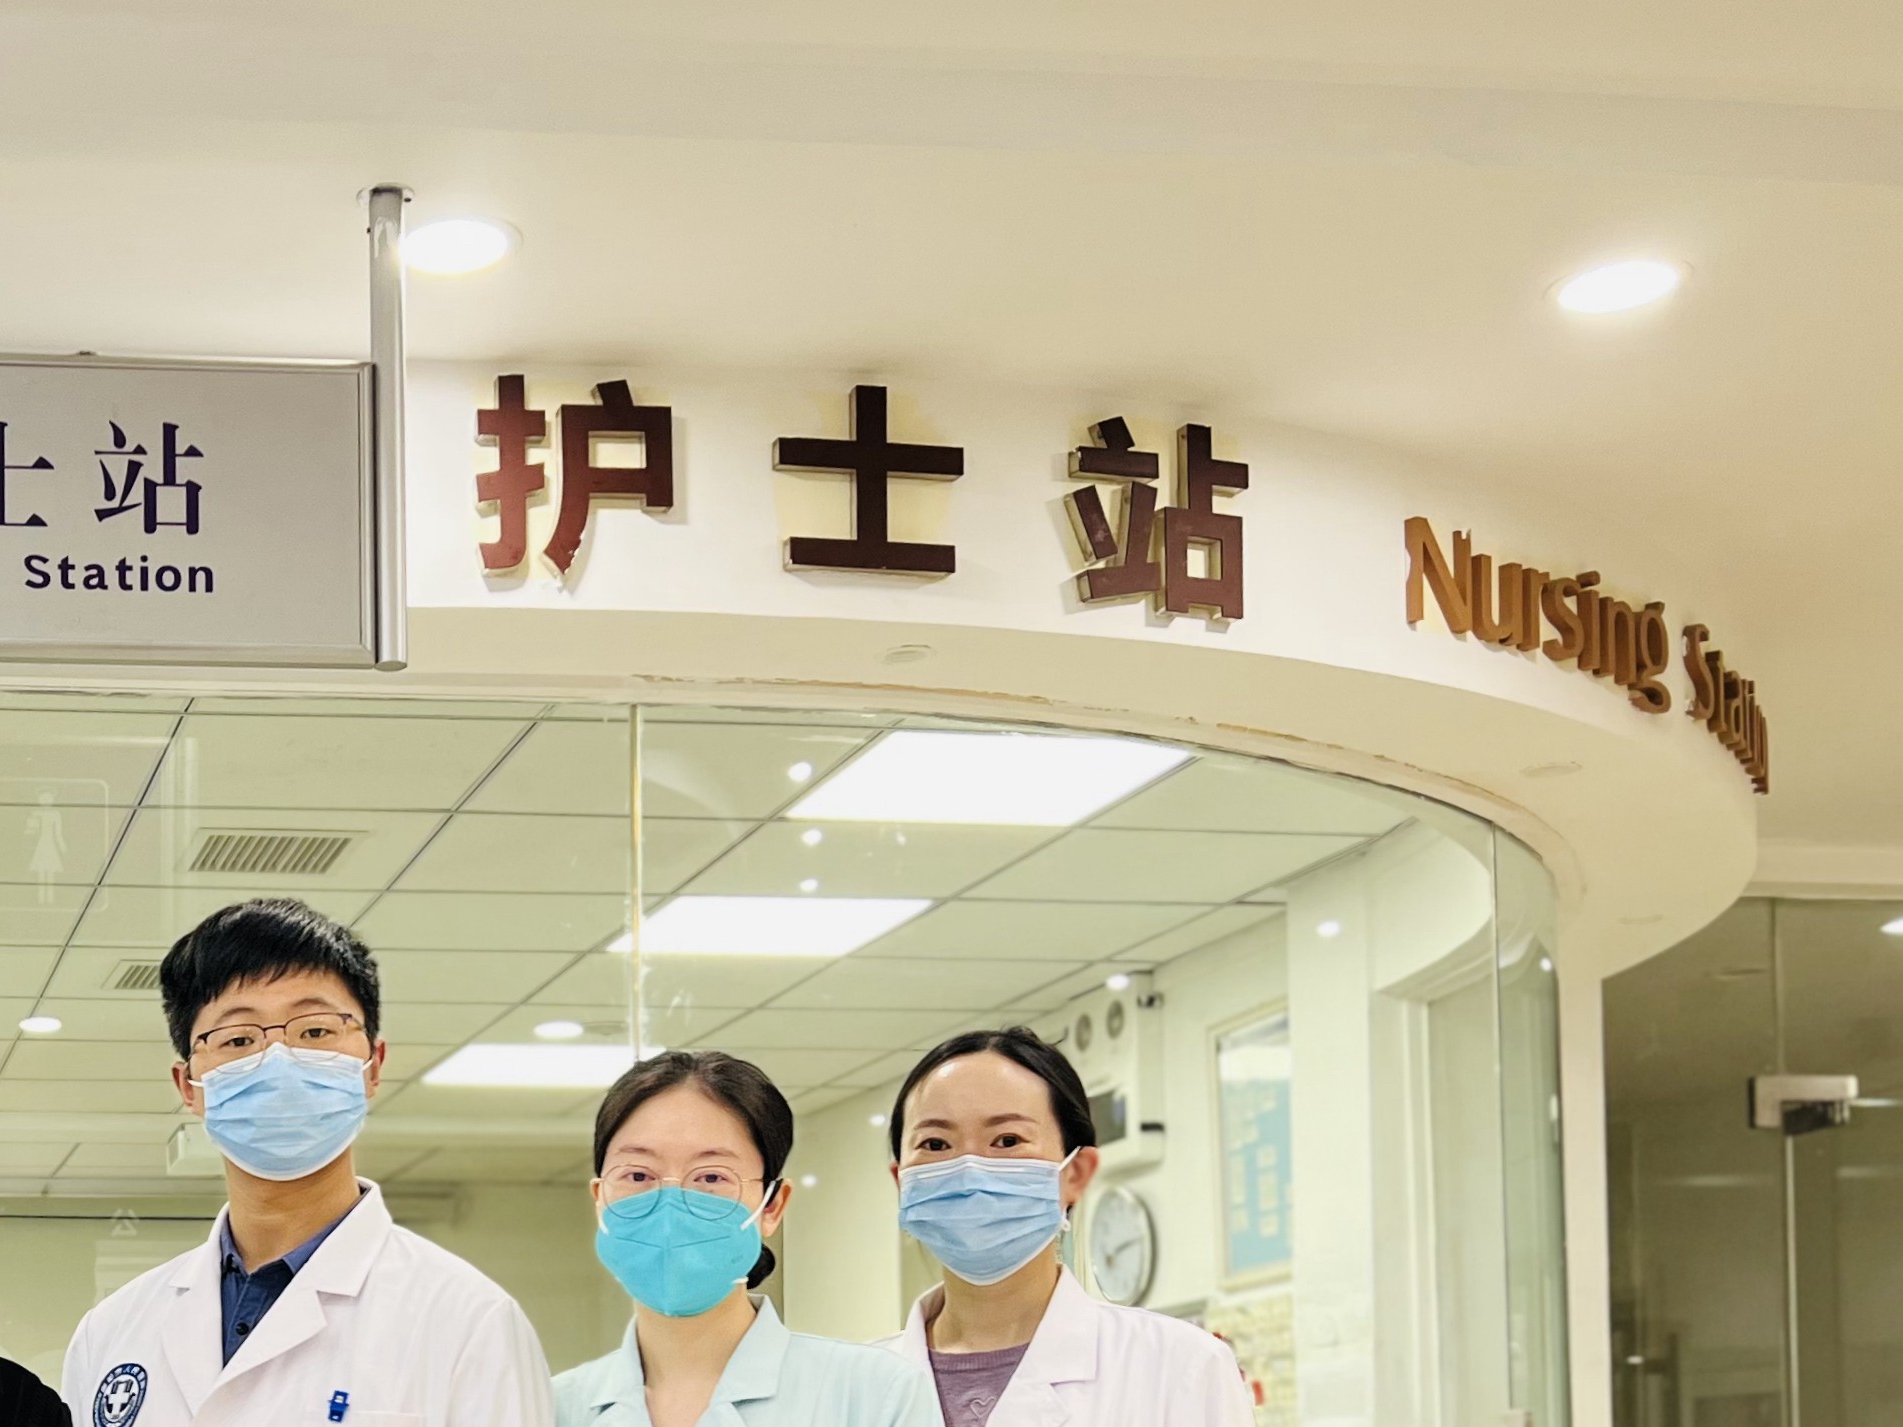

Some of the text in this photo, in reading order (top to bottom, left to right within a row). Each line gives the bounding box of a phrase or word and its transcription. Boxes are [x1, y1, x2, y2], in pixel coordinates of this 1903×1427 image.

[23, 554, 214, 593] Station
[477, 374, 1250, 627] 护士站
[1404, 515, 1672, 715] Nursing
